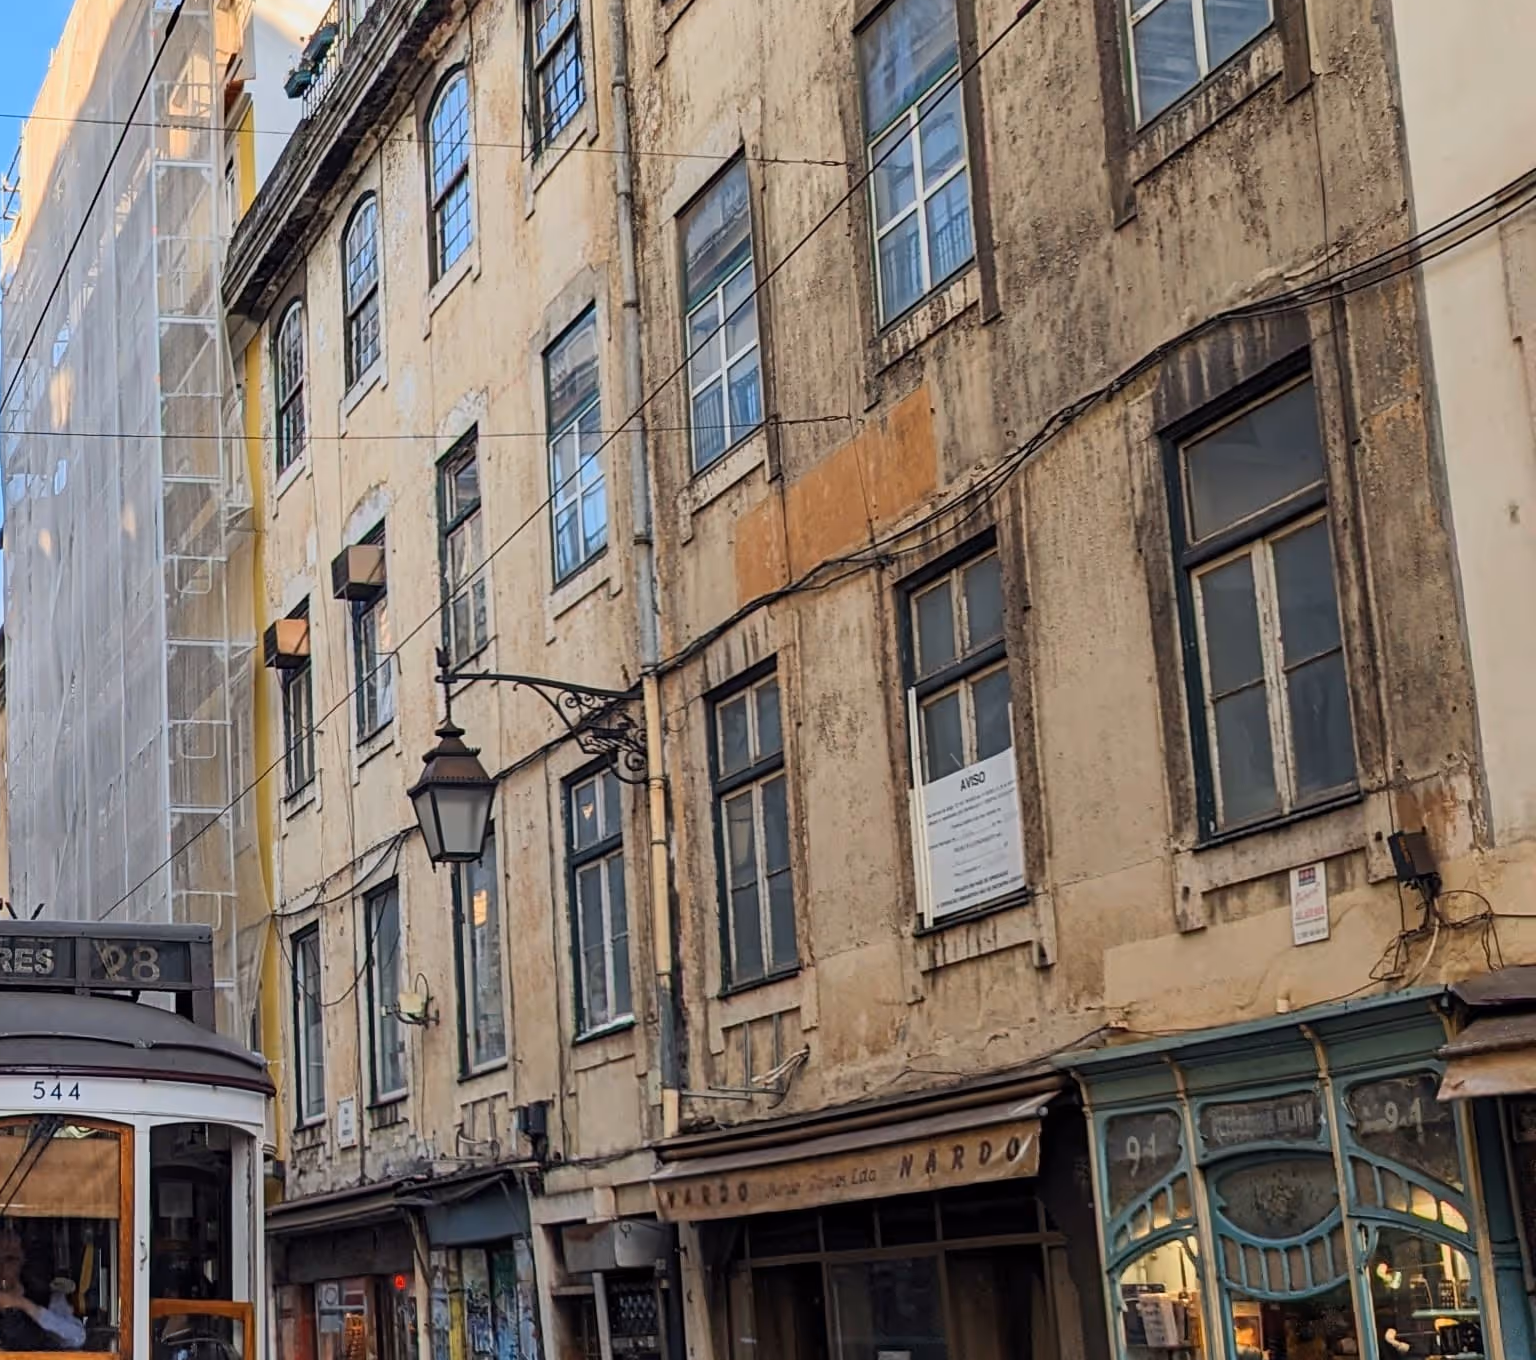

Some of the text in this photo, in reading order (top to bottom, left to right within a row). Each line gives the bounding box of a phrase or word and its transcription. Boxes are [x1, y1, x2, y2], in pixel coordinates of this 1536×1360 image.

[959, 771, 986, 792] AVISO
[32, 1080, 82, 1101] 544
[899, 1136, 1020, 1178] NARDO
